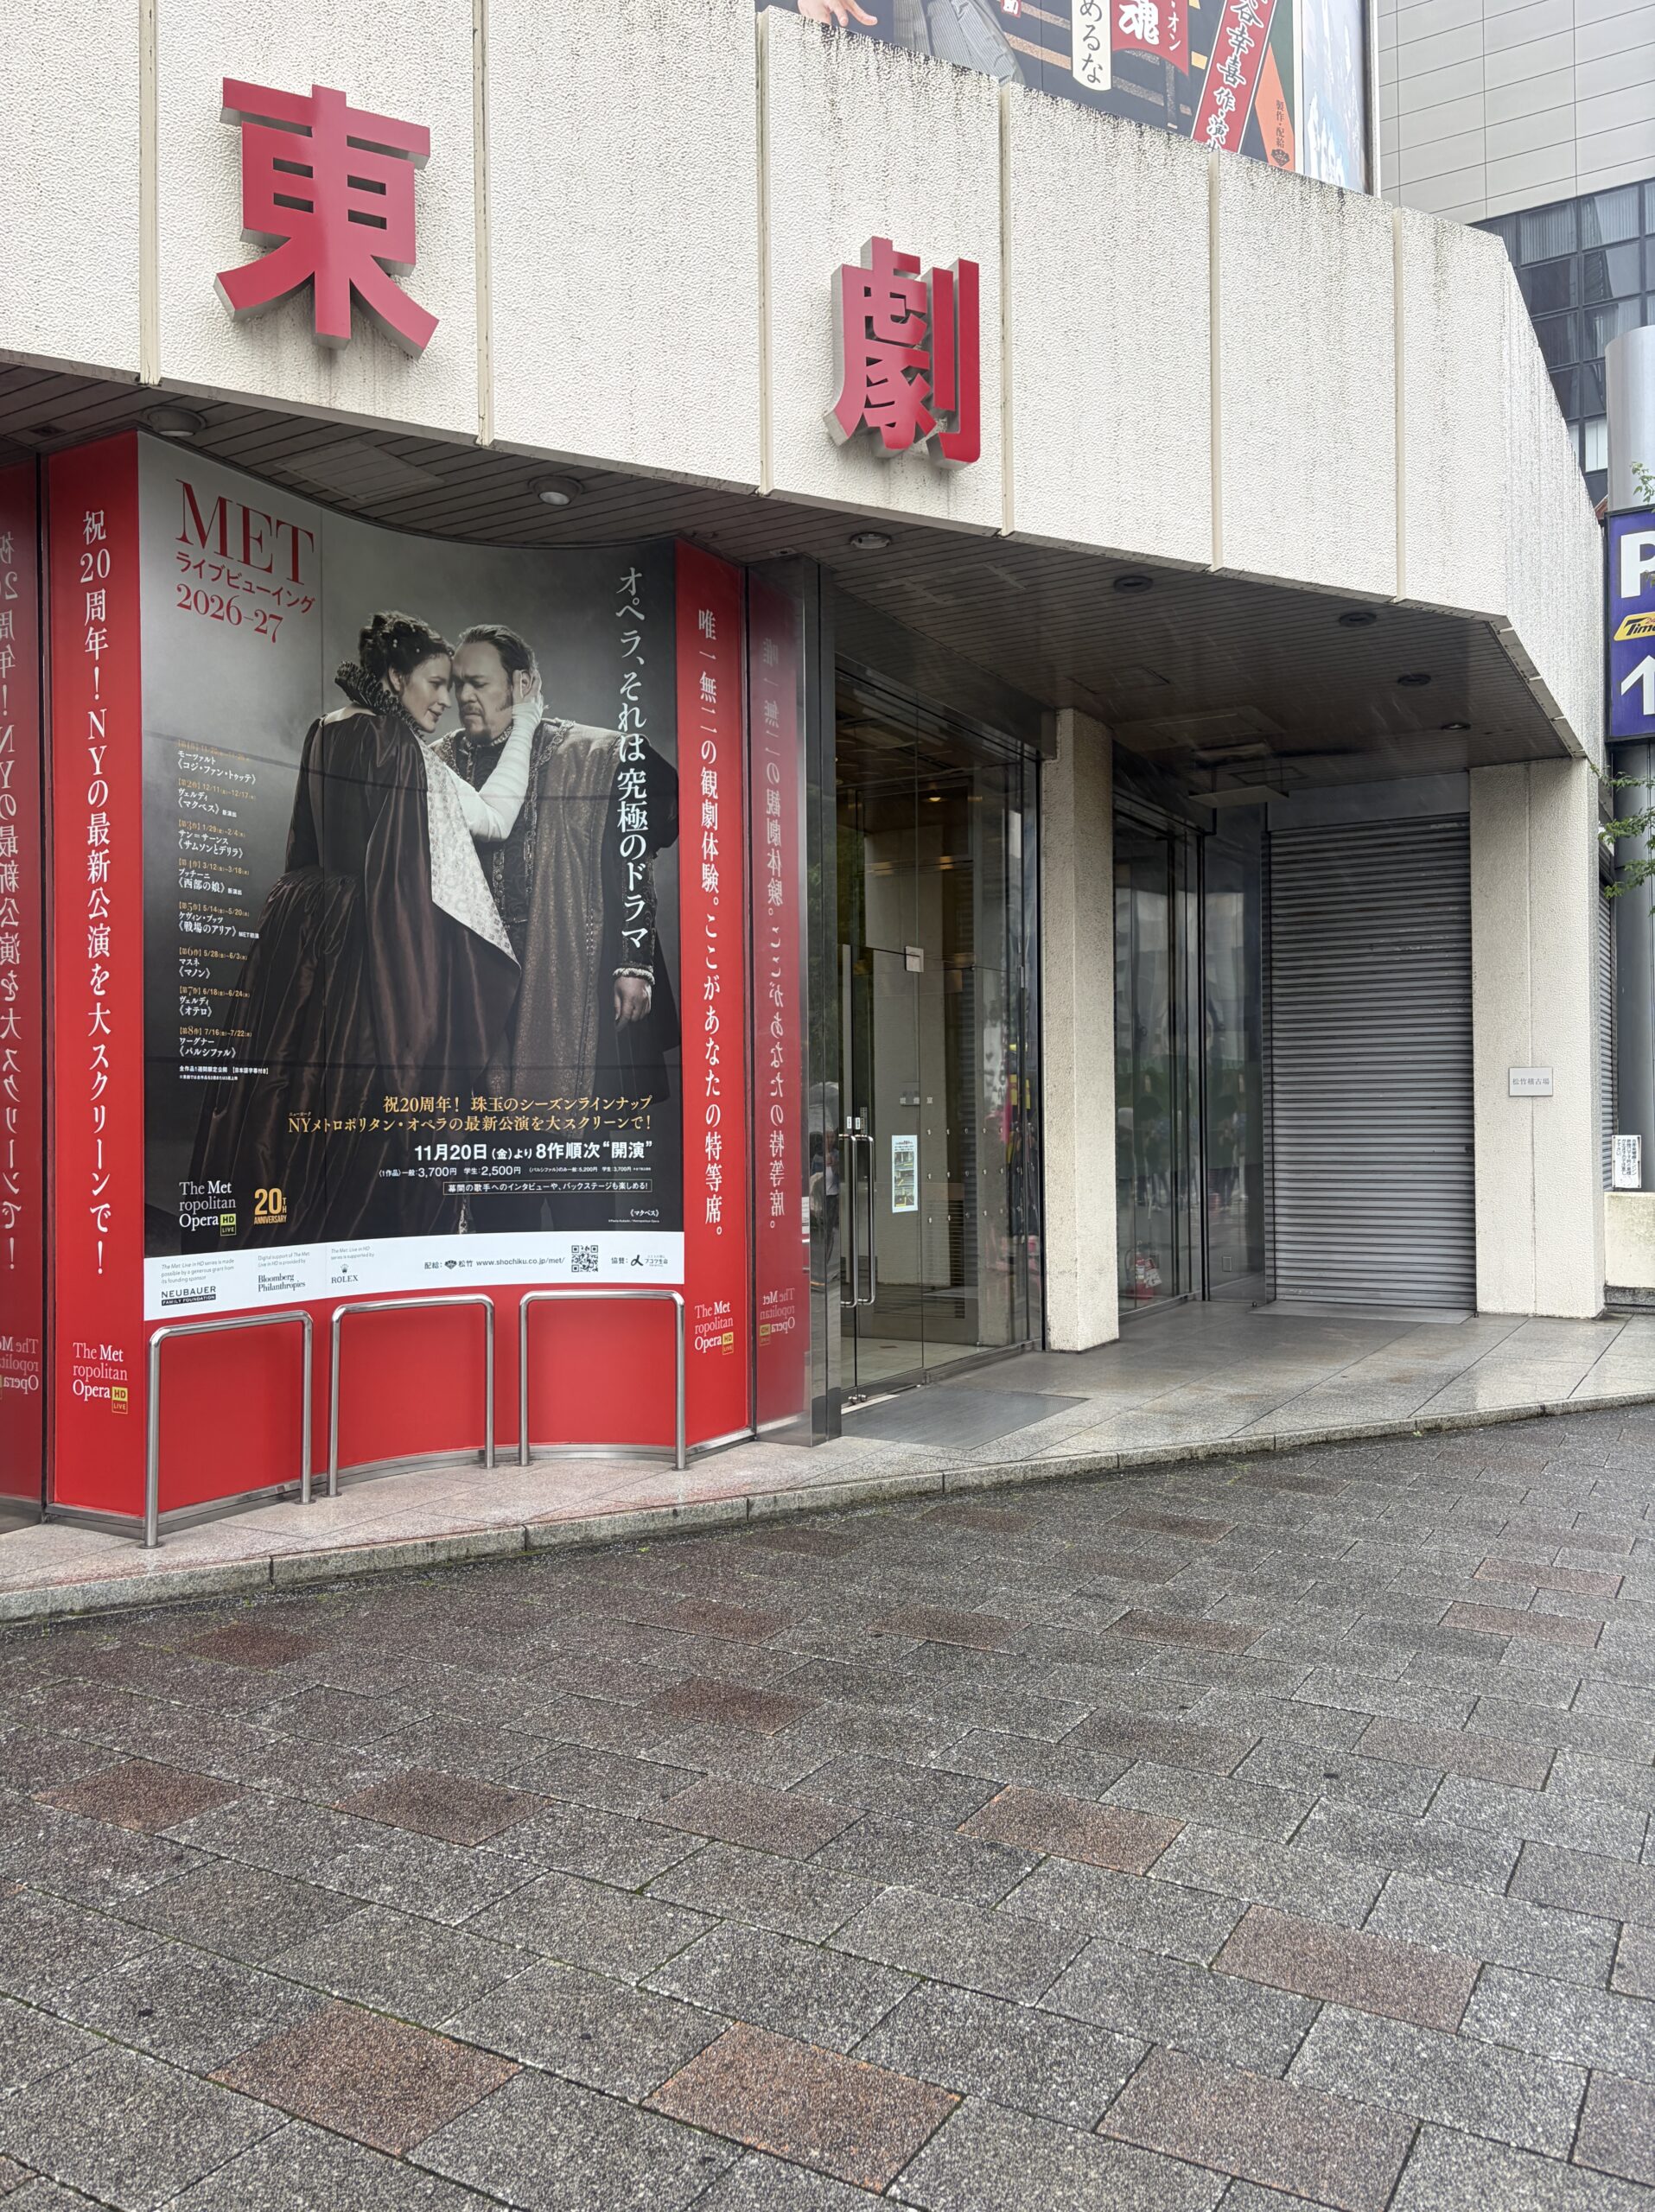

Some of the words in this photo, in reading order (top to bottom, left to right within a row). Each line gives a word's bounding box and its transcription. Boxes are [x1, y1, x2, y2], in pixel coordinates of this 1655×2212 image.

[214, 78, 440, 358] 東
[823, 236, 980, 469] 劇
[175, 479, 315, 585] MET
[1621, 531, 1655, 598] P
[176, 551, 315, 613] ライブビューイング
[176, 583, 283, 643] 2026-27
[1624, 617, 1655, 636] Tim
[178, 751, 215, 765] モーツァルト
[615, 567, 648, 949] オペラ、それは究極のドラマ
[178, 788, 207, 801] ヴェルディ
[178, 868, 210, 880] プッチーニ
[179, 957, 200, 967] マスネ
[179, 995, 208, 1007] ヴェルディ
[179, 1037, 214, 1046] ワーグナー
[383, 1096, 460, 1114] 祝20周年！
[470, 1095, 653, 1113] 珠玉のシーズンラインナップ
[179, 1181, 205, 1195] The
[207, 1180, 232, 1194] Met
[179, 1196, 236, 1215] ropolitan
[179, 1213, 219, 1231] Opera
[254, 1215, 287, 1225] ANNIVERSARY
[476, 1257, 565, 1266] www.shochiku.co.jp/met/
[258, 1273, 295, 1283] Bloomberg
[258, 1280, 306, 1293] Philanthropies
[331, 1274, 359, 1284] ROLEX
[162, 1286, 216, 1299] NEUBAUER
[695, 1304, 712, 1319] The
[714, 1300, 730, 1315] Met
[695, 1317, 733, 1337] ropolitan
[73, 1342, 97, 1359] The
[99, 1344, 124, 1362] Met
[695, 1336, 722, 1353] Opera
[73, 1363, 128, 1382] ropolitan
[73, 1379, 111, 1402] Opera
[114, 1389, 126, 1399] HD
